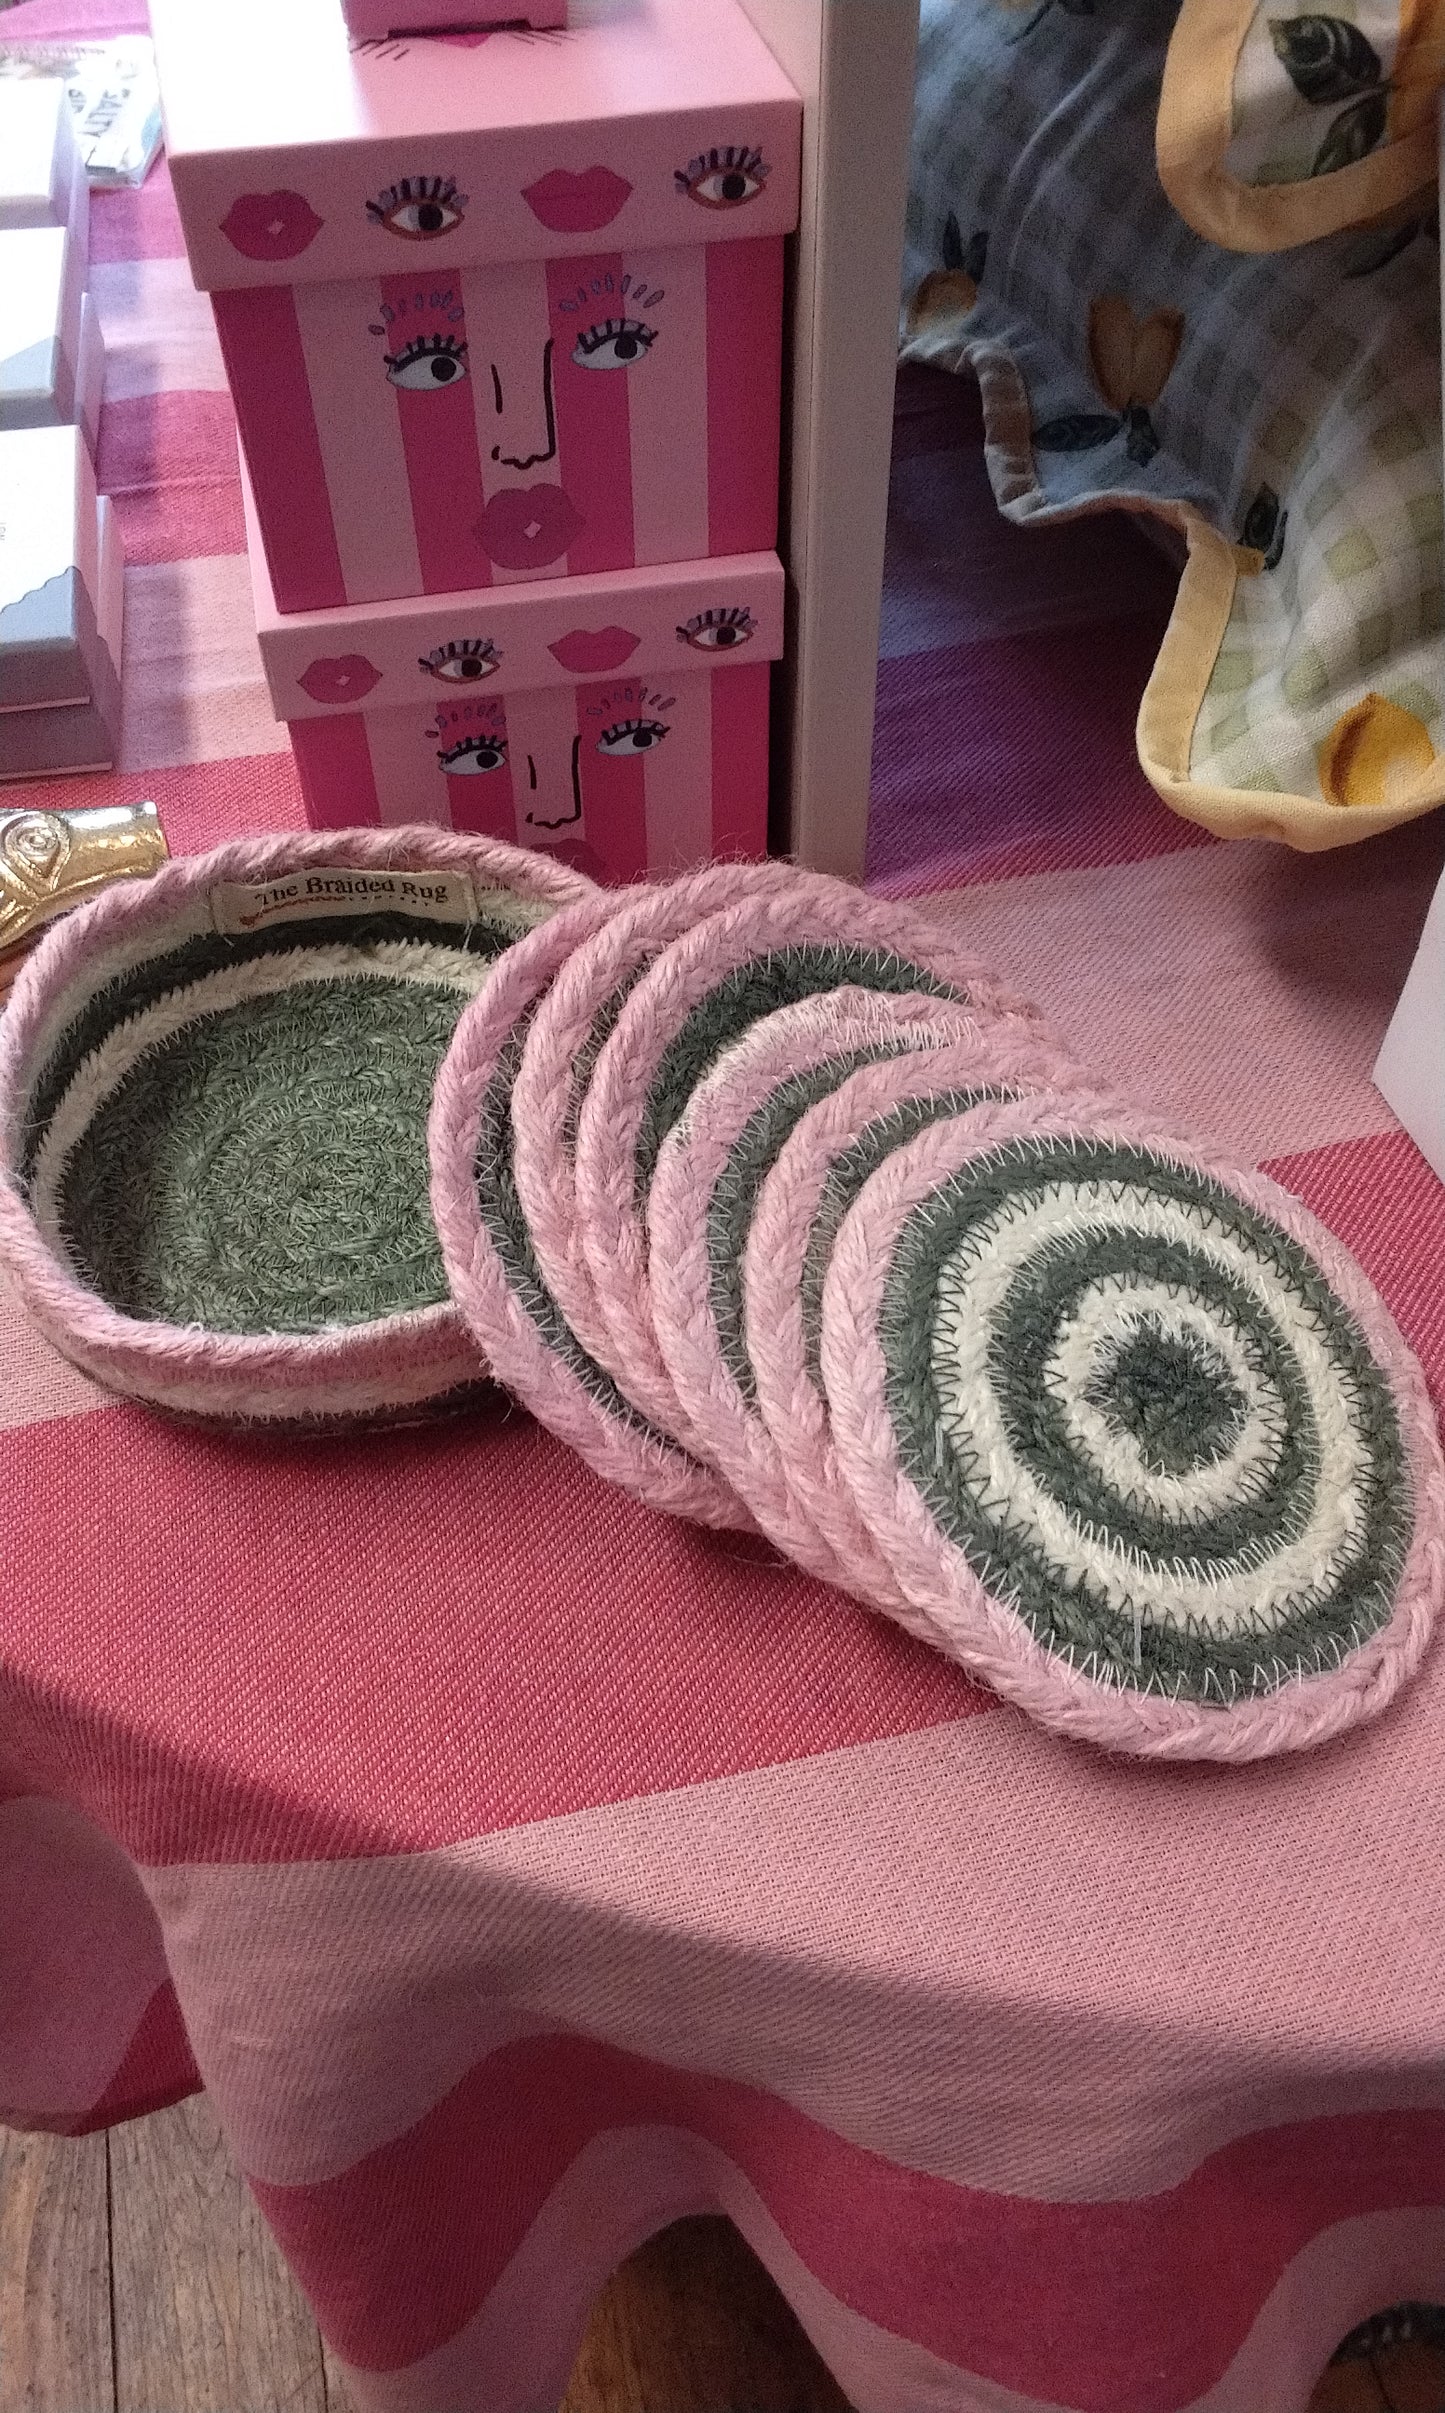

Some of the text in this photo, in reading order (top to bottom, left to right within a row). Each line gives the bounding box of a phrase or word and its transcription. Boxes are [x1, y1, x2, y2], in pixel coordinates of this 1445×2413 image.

[254, 877, 449, 905] The Braided Rug
